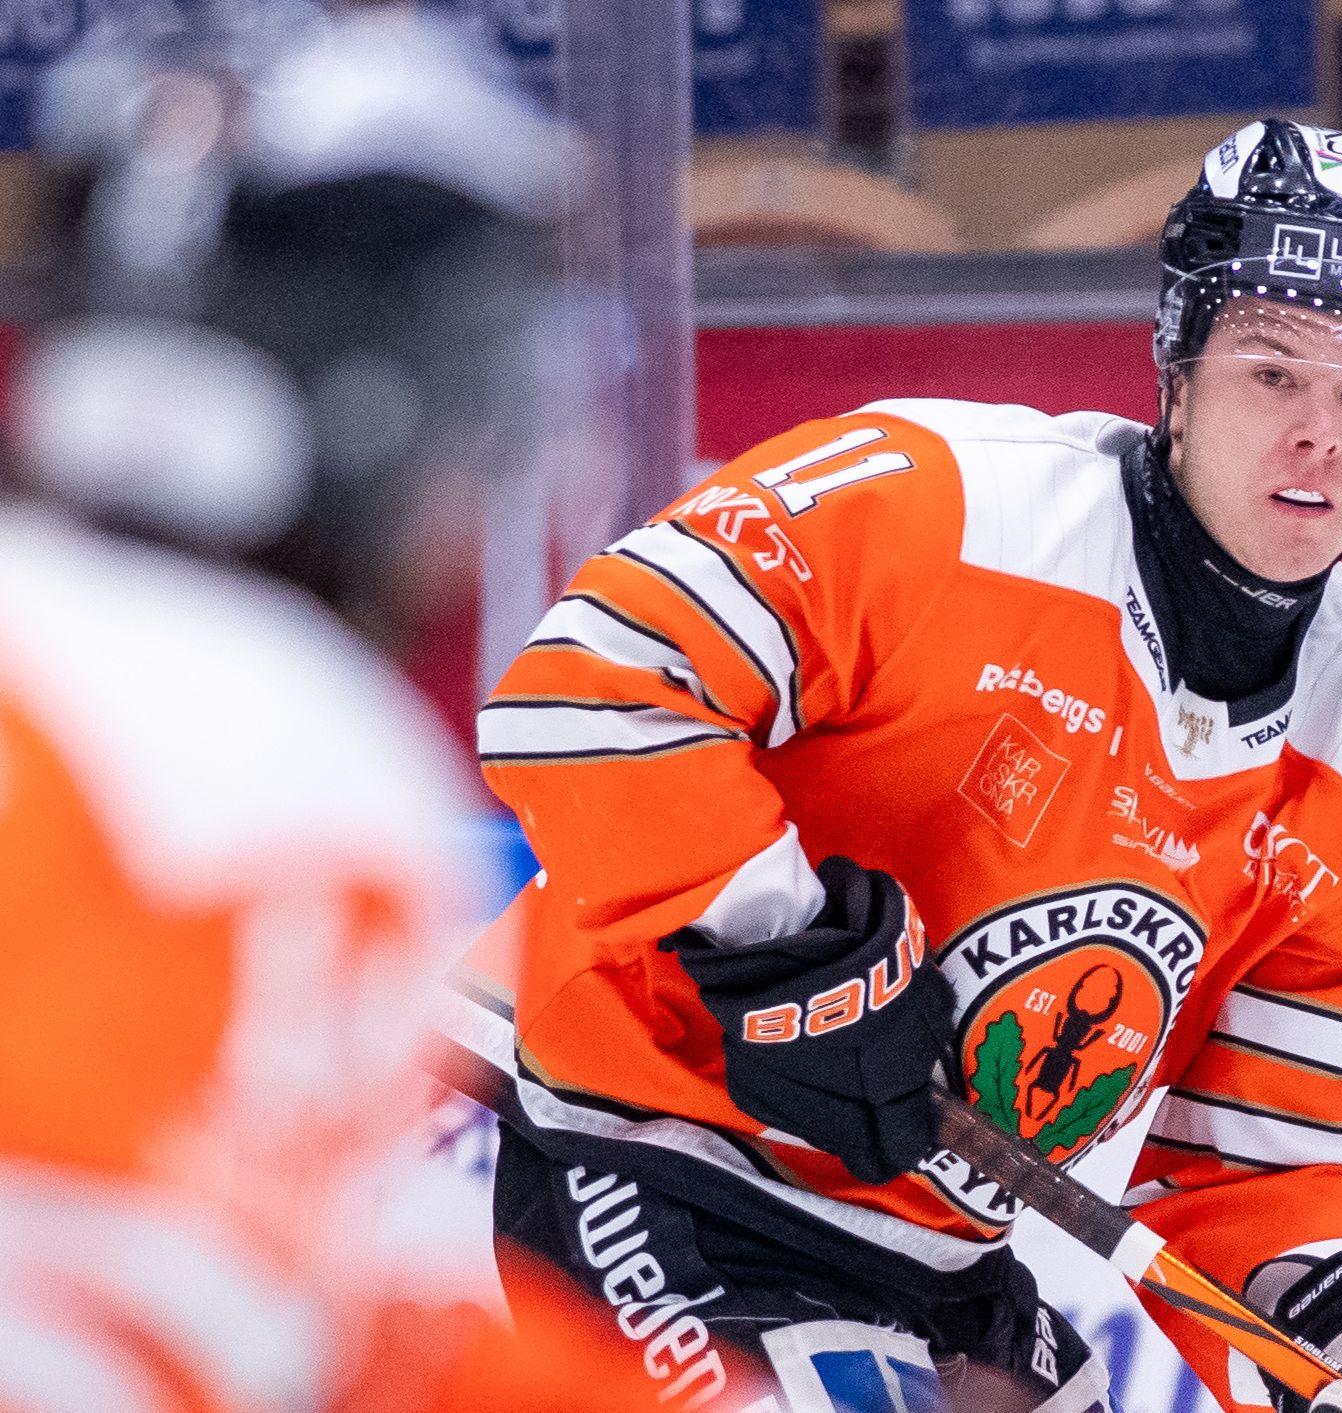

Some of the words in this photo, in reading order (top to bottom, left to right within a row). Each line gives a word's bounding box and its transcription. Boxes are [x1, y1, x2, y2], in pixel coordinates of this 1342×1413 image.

[752, 427, 915, 519] 11
[1240, 706, 1293, 750] TEAM
[1000, 735, 1043, 780] KAR
[1107, 1022, 1149, 1055] 2001
